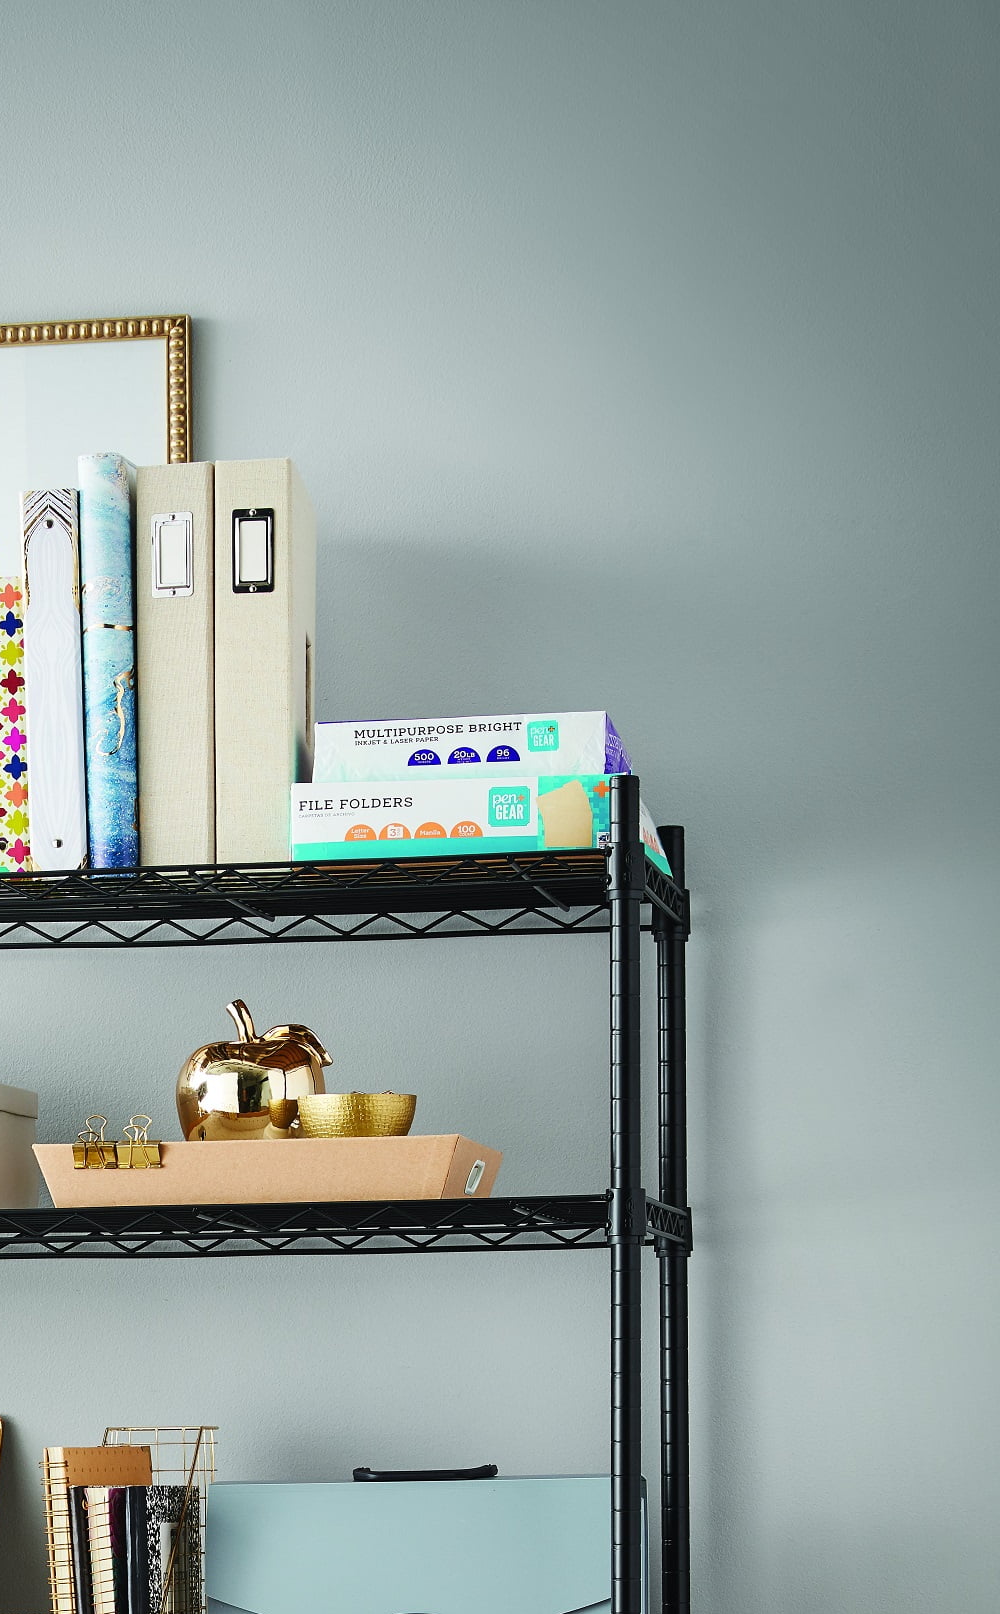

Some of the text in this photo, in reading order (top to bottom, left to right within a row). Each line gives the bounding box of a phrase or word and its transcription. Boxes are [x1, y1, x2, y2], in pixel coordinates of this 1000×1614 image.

[354, 721, 522, 739] MULTIPURPOSE BRIGHT
[355, 738, 381, 746] INKJET
[533, 735, 555, 748] GEAR
[414, 752, 434, 761] 500
[454, 751, 475, 759] 20LB
[496, 749, 510, 757] 96
[299, 797, 413, 811] FILE FOLDERS
[496, 804, 523, 820] GEAR
[457, 825, 476, 834] 100
